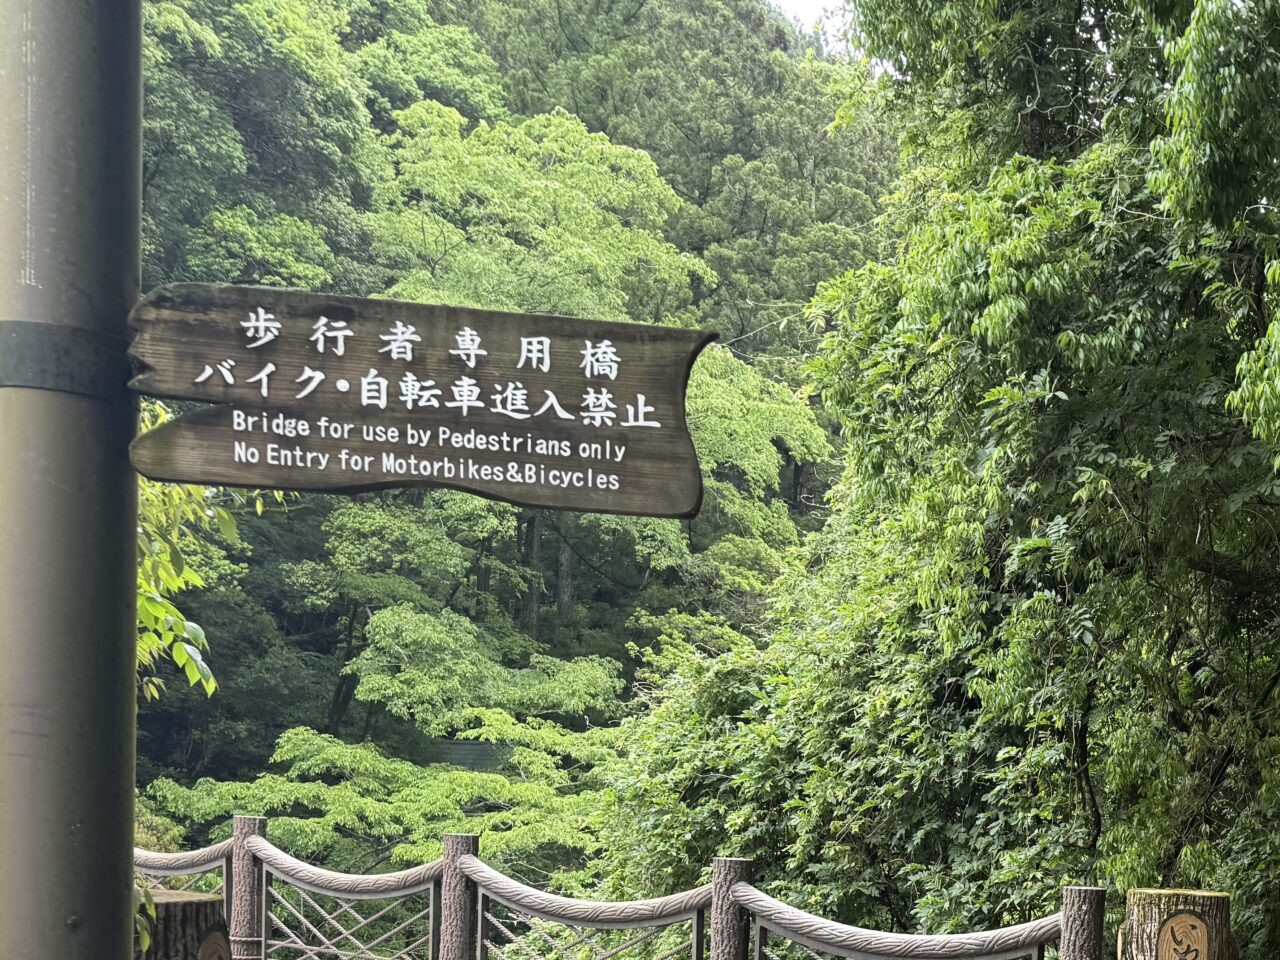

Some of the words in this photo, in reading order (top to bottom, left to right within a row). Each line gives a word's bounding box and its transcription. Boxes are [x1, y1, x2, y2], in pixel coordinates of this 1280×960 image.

[240, 306, 622, 381] 歩行者専用橋
[194, 358, 662, 428] バイク・自転車進入禁止
[232, 409, 310, 437] Bridge
[316, 416, 355, 439] for
[362, 424, 400, 443] use
[407, 423, 432, 447] by
[438, 426, 572, 457] Pedestrians
[578, 439, 626, 461] only
[234, 440, 260, 464] No
[266, 443, 329, 470] Entry
[337, 448, 375, 472] for
[381, 452, 620, 490] Motorbikes&Bicycles
